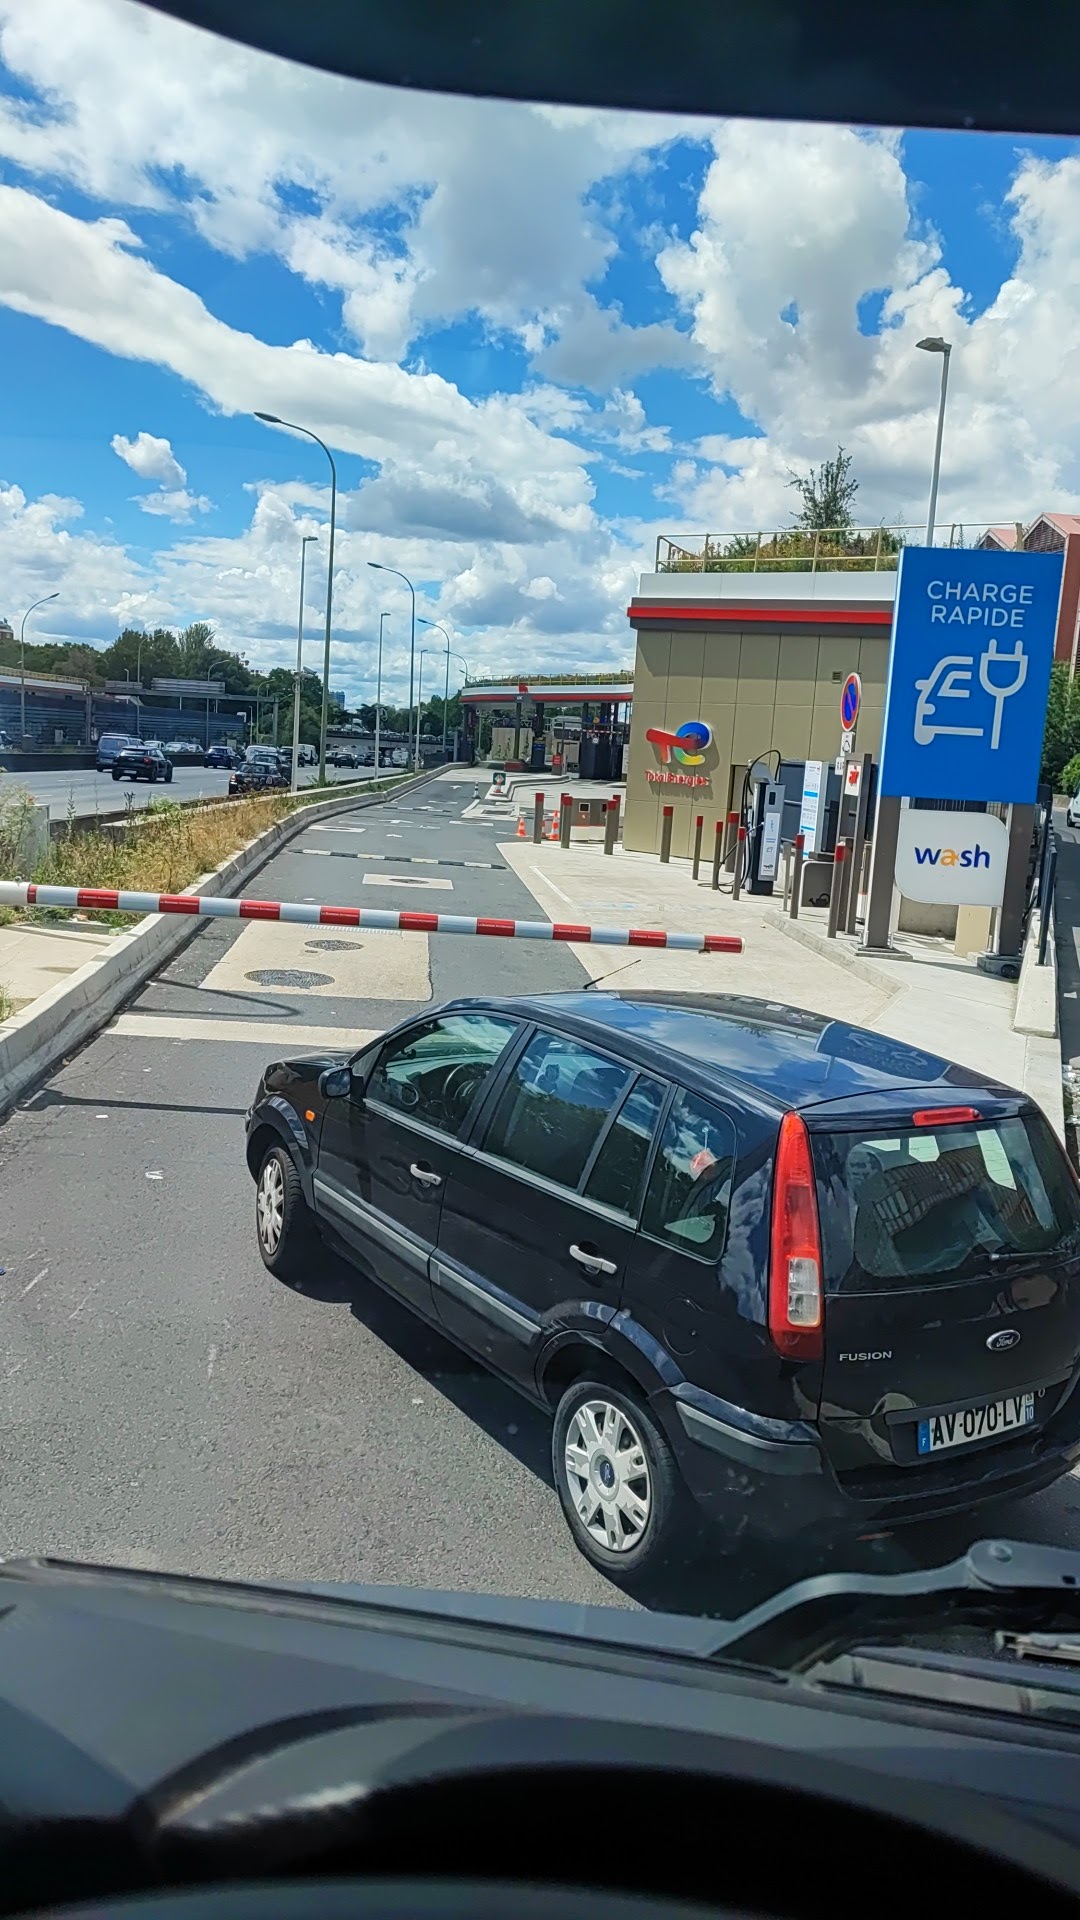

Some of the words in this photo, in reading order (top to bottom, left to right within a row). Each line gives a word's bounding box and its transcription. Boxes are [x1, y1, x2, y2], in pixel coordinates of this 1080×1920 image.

[927, 580, 1034, 605] CHARGE
[931, 604, 1025, 628] RAPIDE
[914, 844, 990, 869] wash
[996, 1335, 1015, 1348] Ford
[839, 1350, 893, 1362] FUSION
